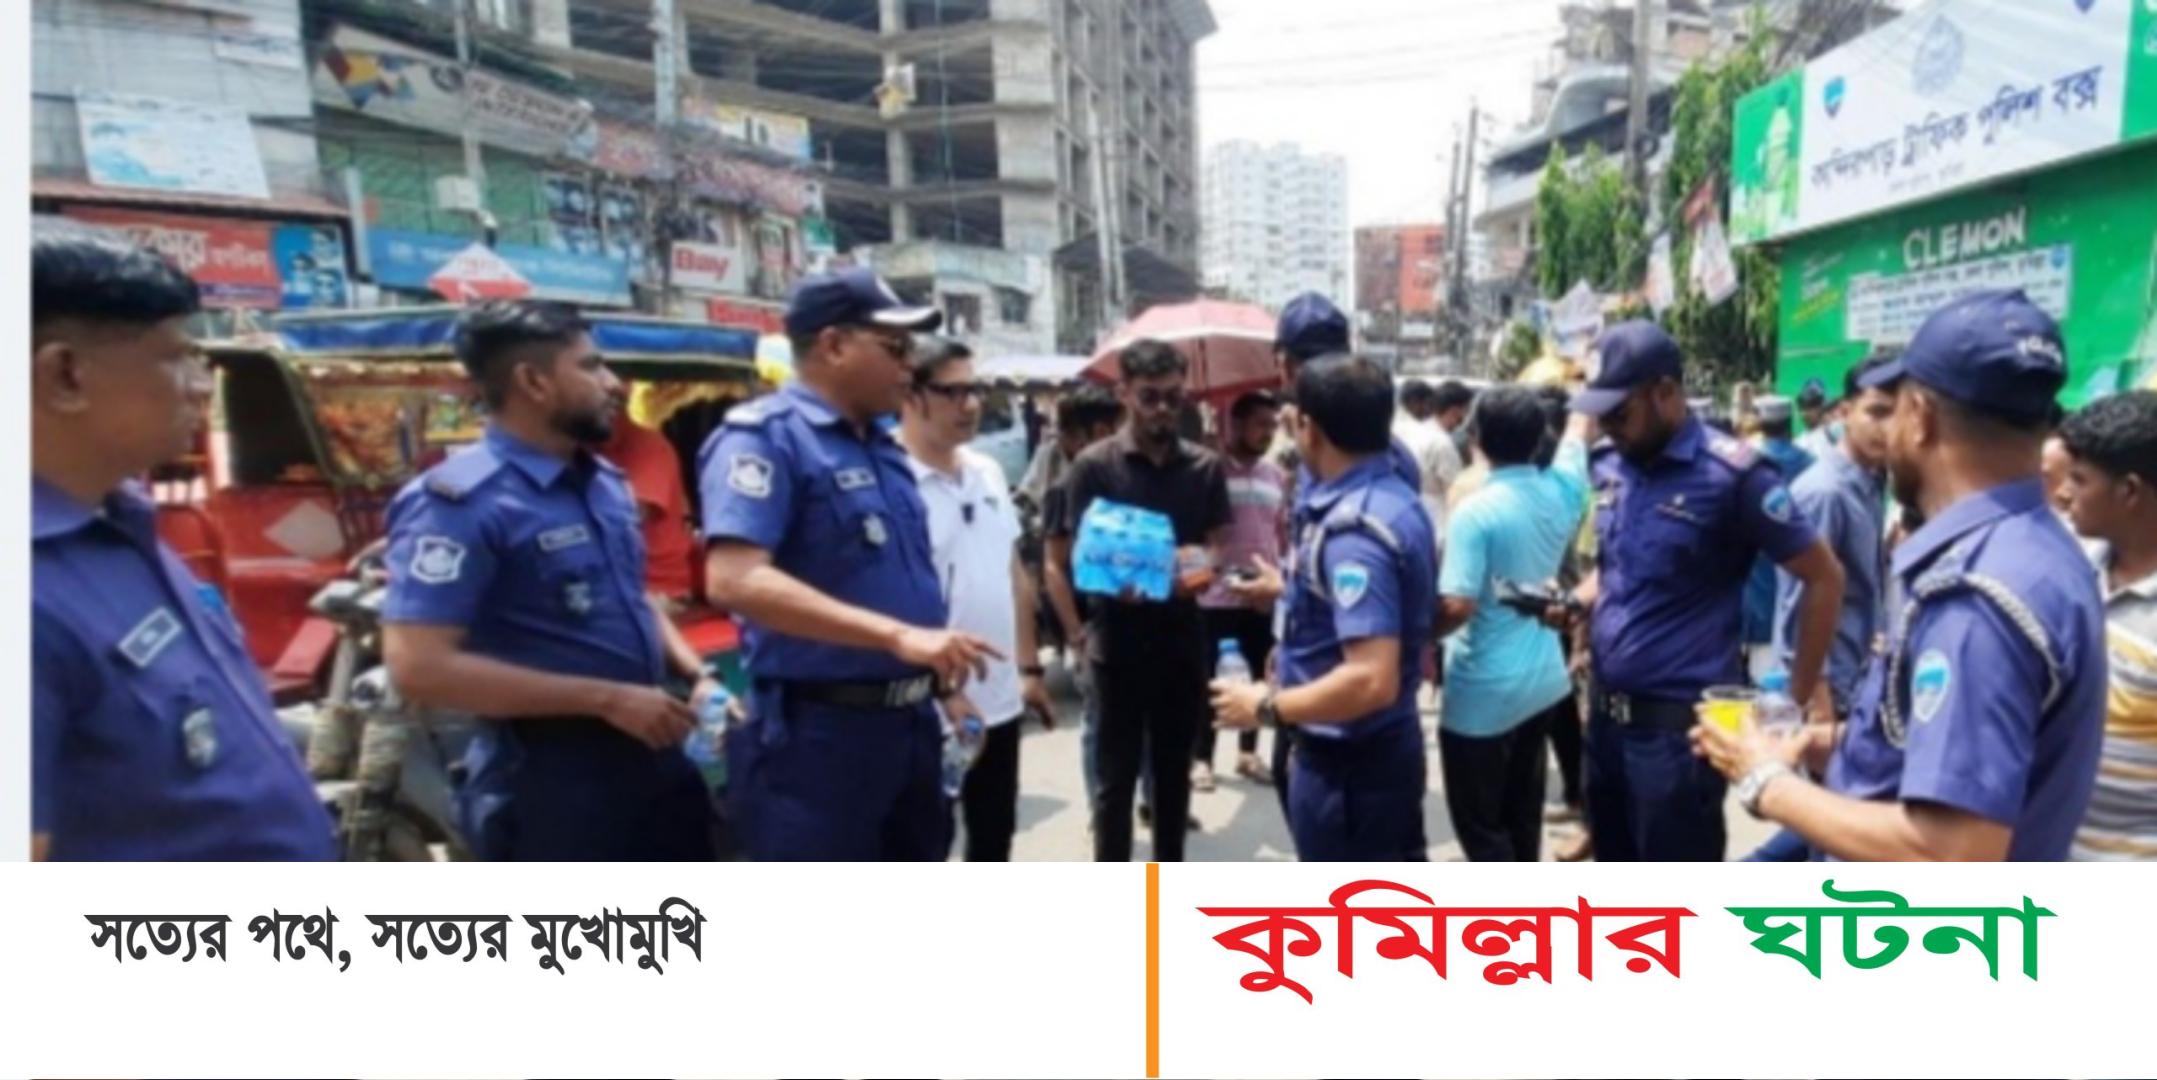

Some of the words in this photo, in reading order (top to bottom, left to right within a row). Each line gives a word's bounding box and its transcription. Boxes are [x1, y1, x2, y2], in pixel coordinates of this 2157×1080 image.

[1901, 111, 1970, 166] ট্রাফিক
[1977, 84, 2043, 145] পুলিশ
[2051, 65, 2102, 113] বক্স
[676, 248, 728, 282] Bay
[1903, 206, 2026, 269] CLEMON
